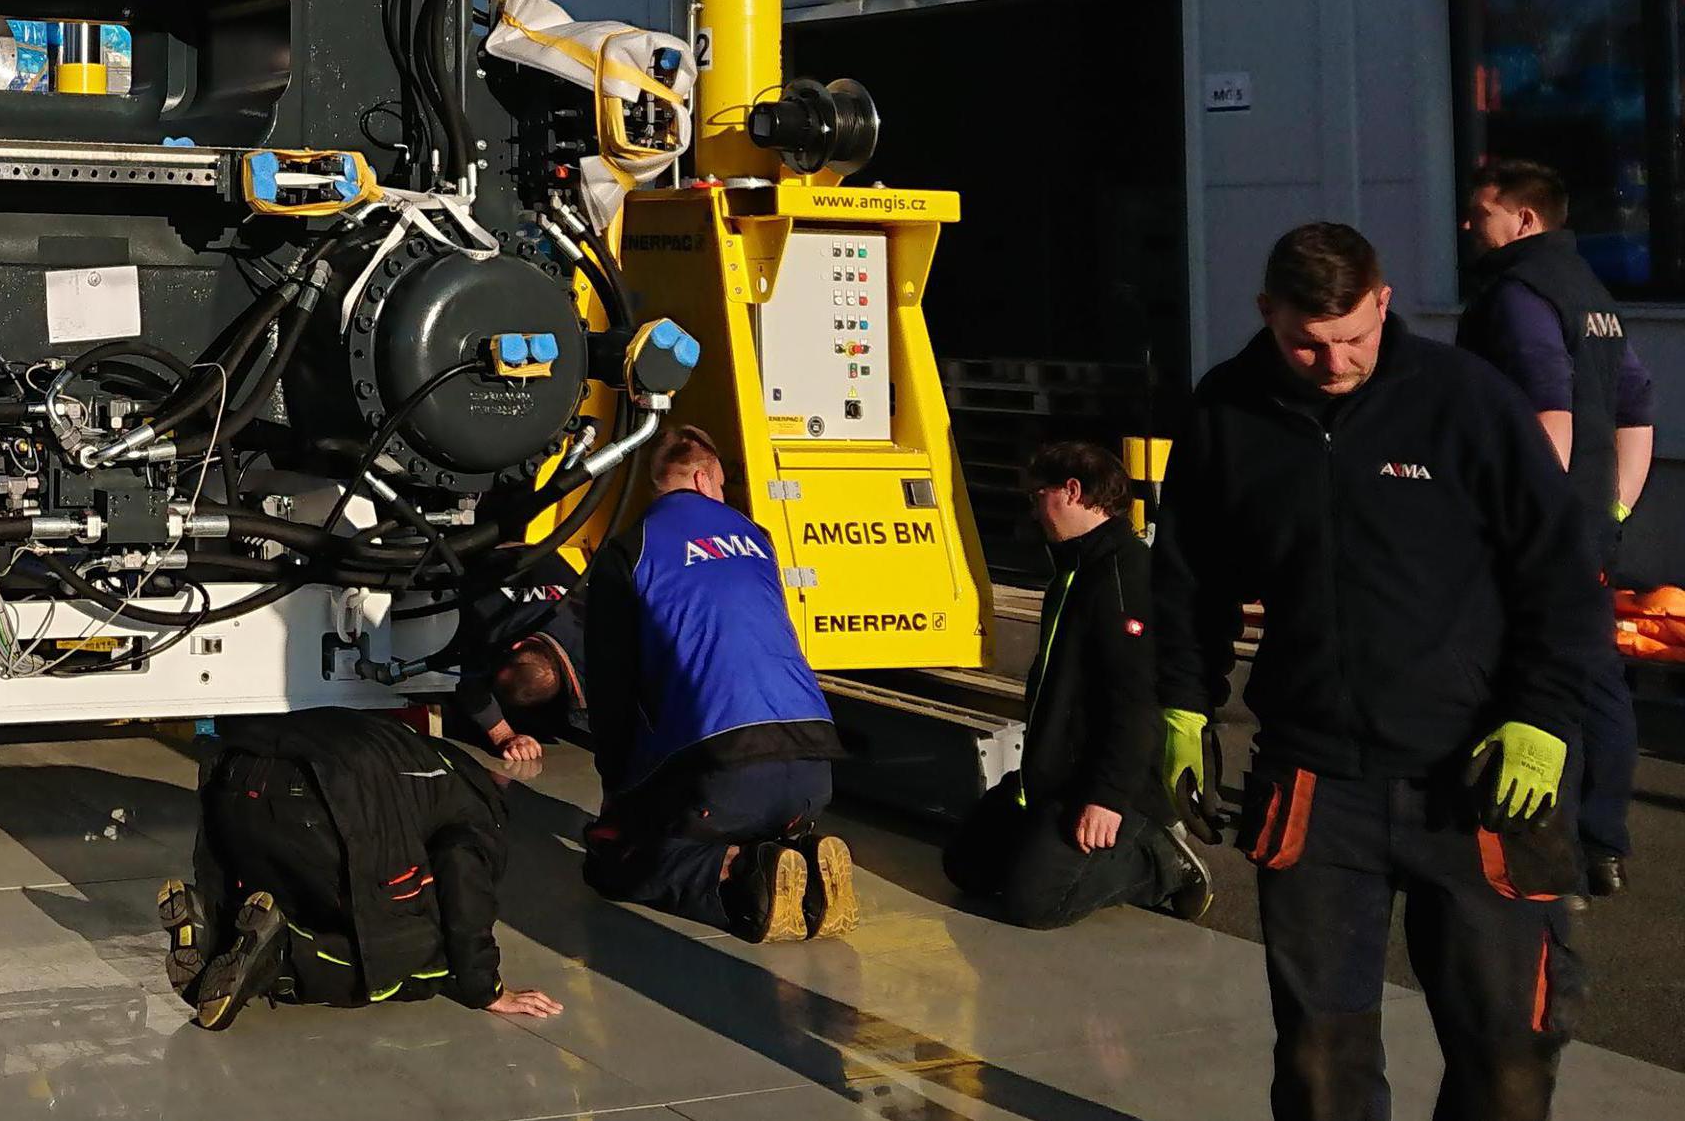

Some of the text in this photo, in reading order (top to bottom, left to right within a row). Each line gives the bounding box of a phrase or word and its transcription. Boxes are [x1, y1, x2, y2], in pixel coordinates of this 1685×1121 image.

[696, 33, 711, 67] 2
[812, 194, 928, 213] www.amgis.cz
[803, 522, 936, 545] AMGIS BM
[684, 534, 770, 567] AXMA
[814, 612, 928, 633] ENERPAC
